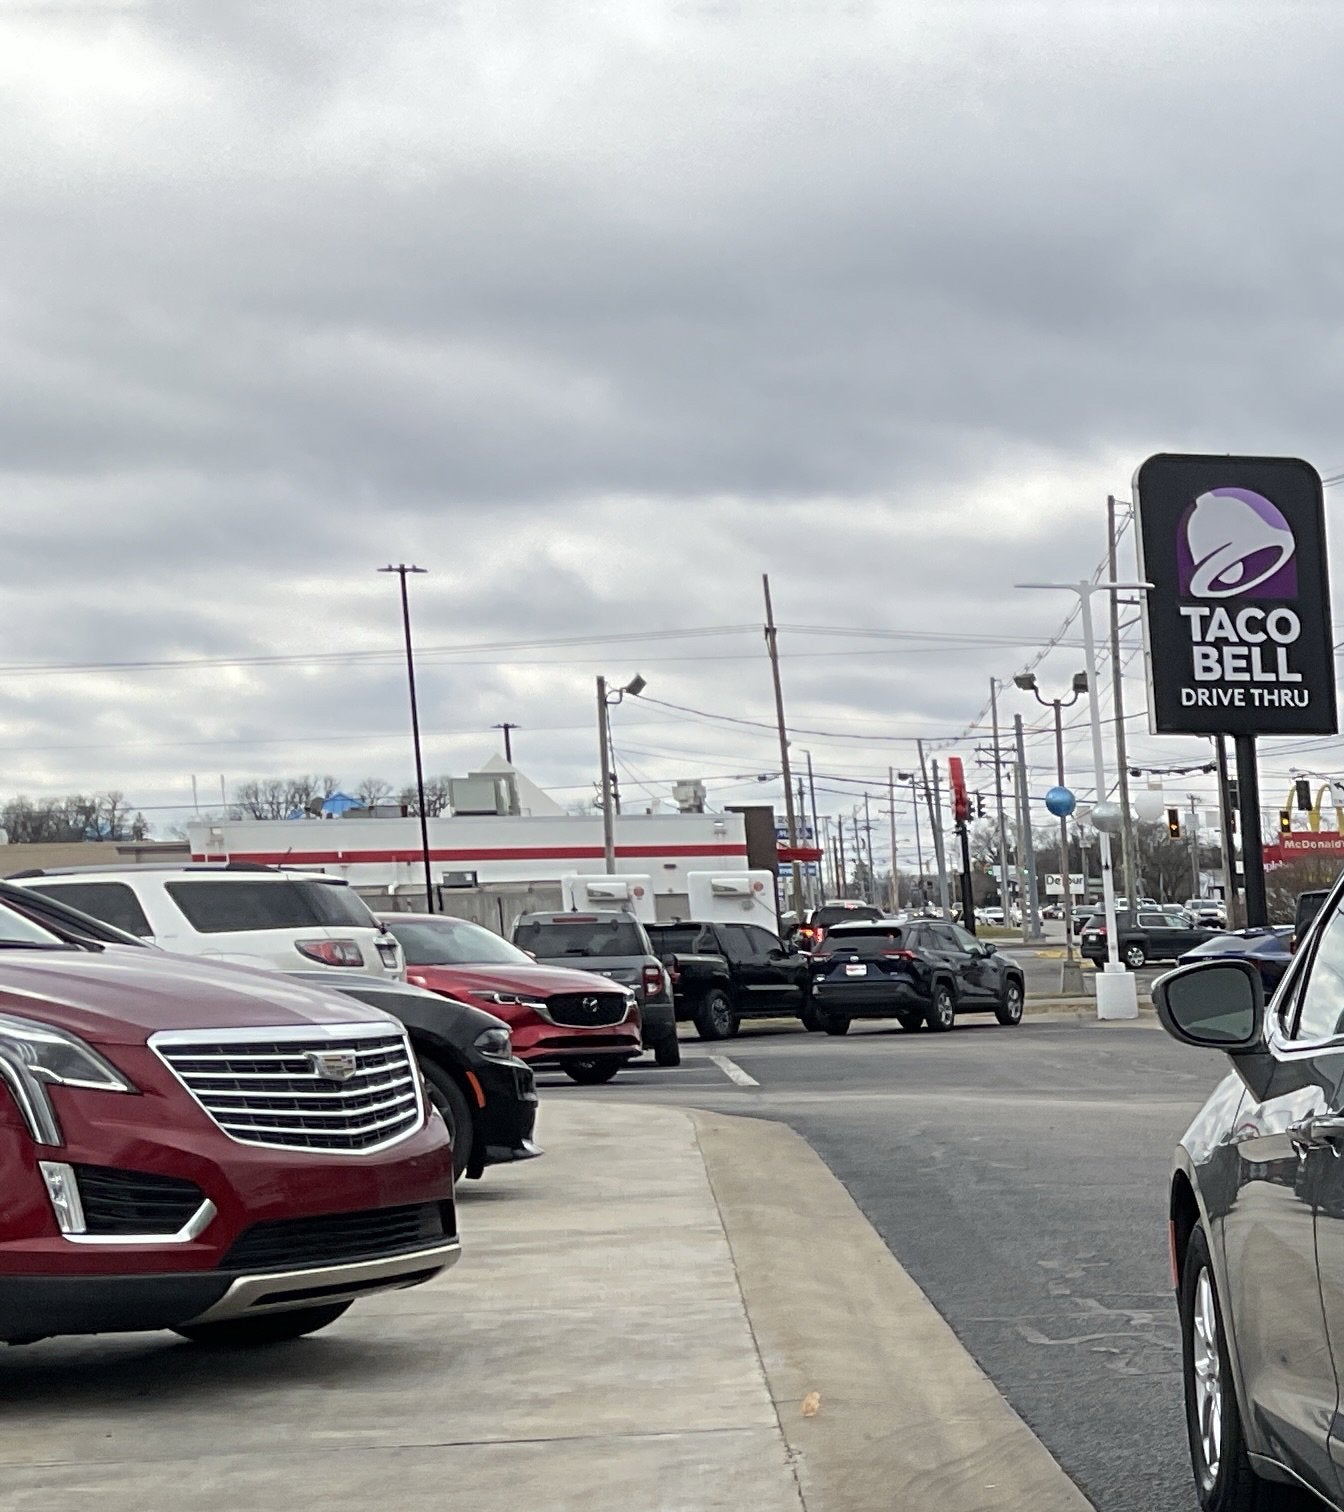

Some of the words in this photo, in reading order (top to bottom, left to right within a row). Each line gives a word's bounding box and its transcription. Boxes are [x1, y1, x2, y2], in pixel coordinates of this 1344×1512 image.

[1179, 606, 1301, 644] TACO
[1192, 645, 1303, 682] BELL
[1181, 688, 1246, 707] DRIVE
[1250, 688, 1309, 708] THRU
